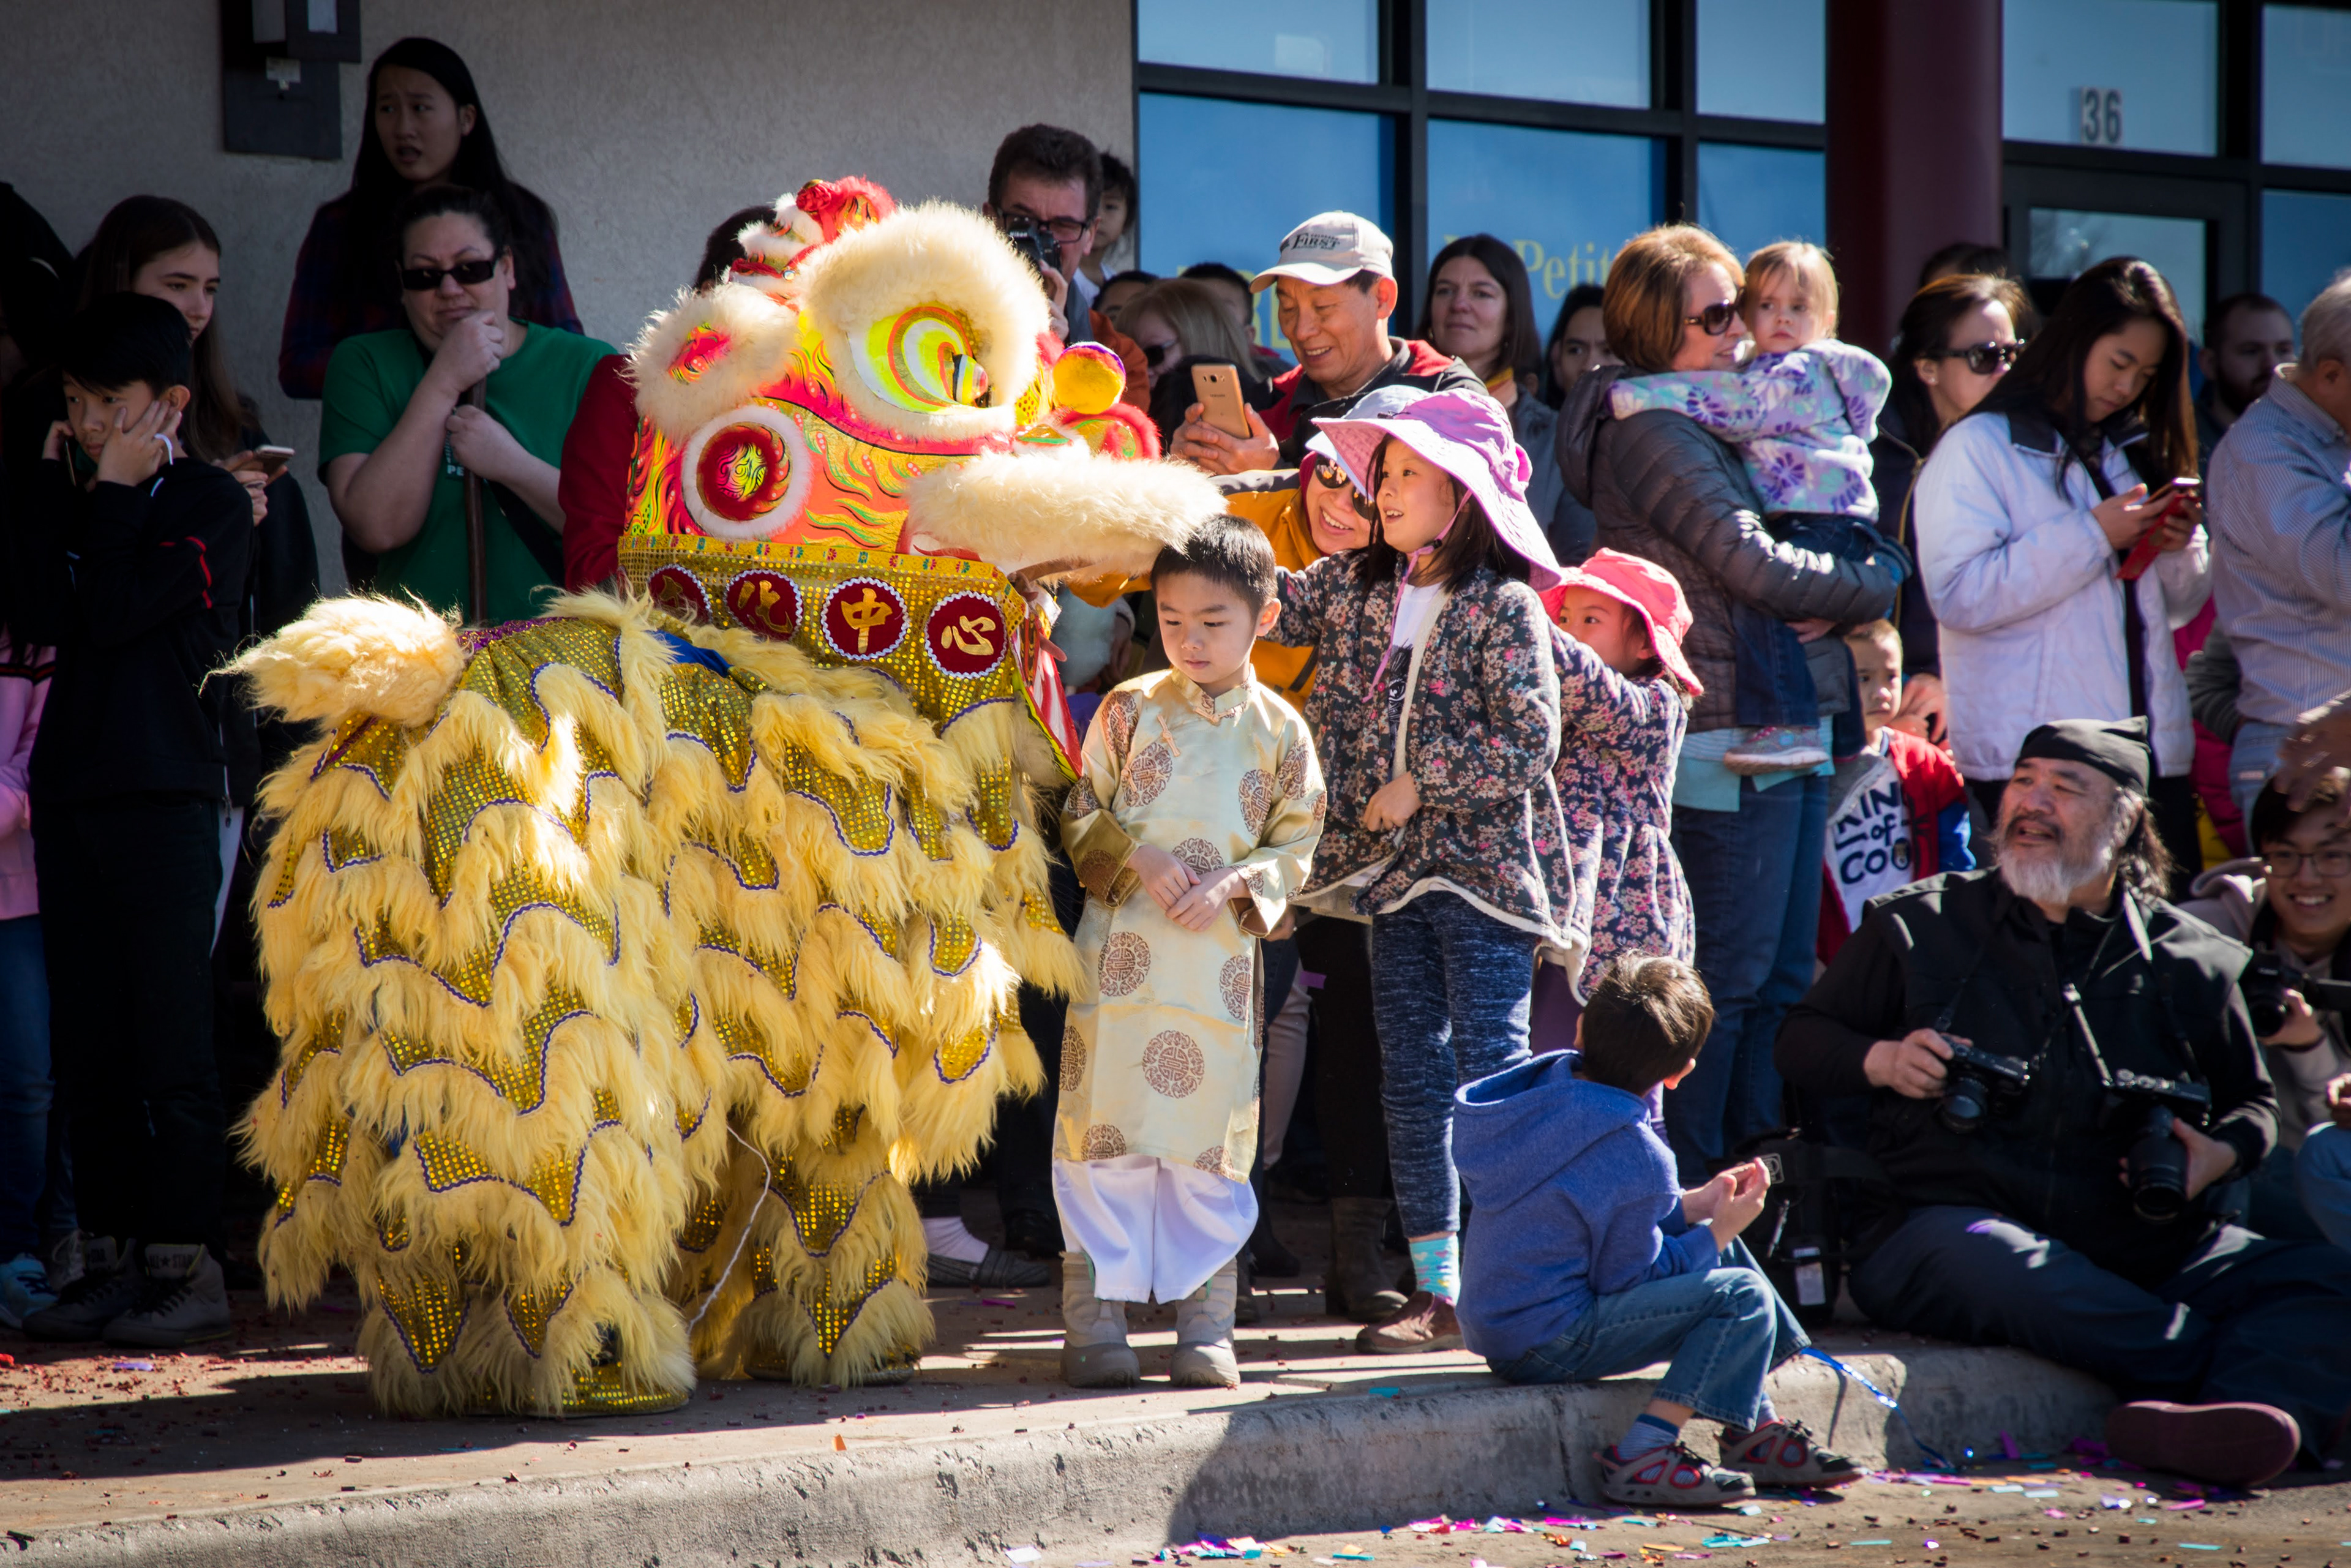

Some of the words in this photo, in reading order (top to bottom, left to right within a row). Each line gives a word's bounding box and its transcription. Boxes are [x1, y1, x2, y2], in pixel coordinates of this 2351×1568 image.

[2083, 88, 2123, 144] 36
[1290, 233, 1340, 250] FIRST
[1871, 813, 1897, 847] of
